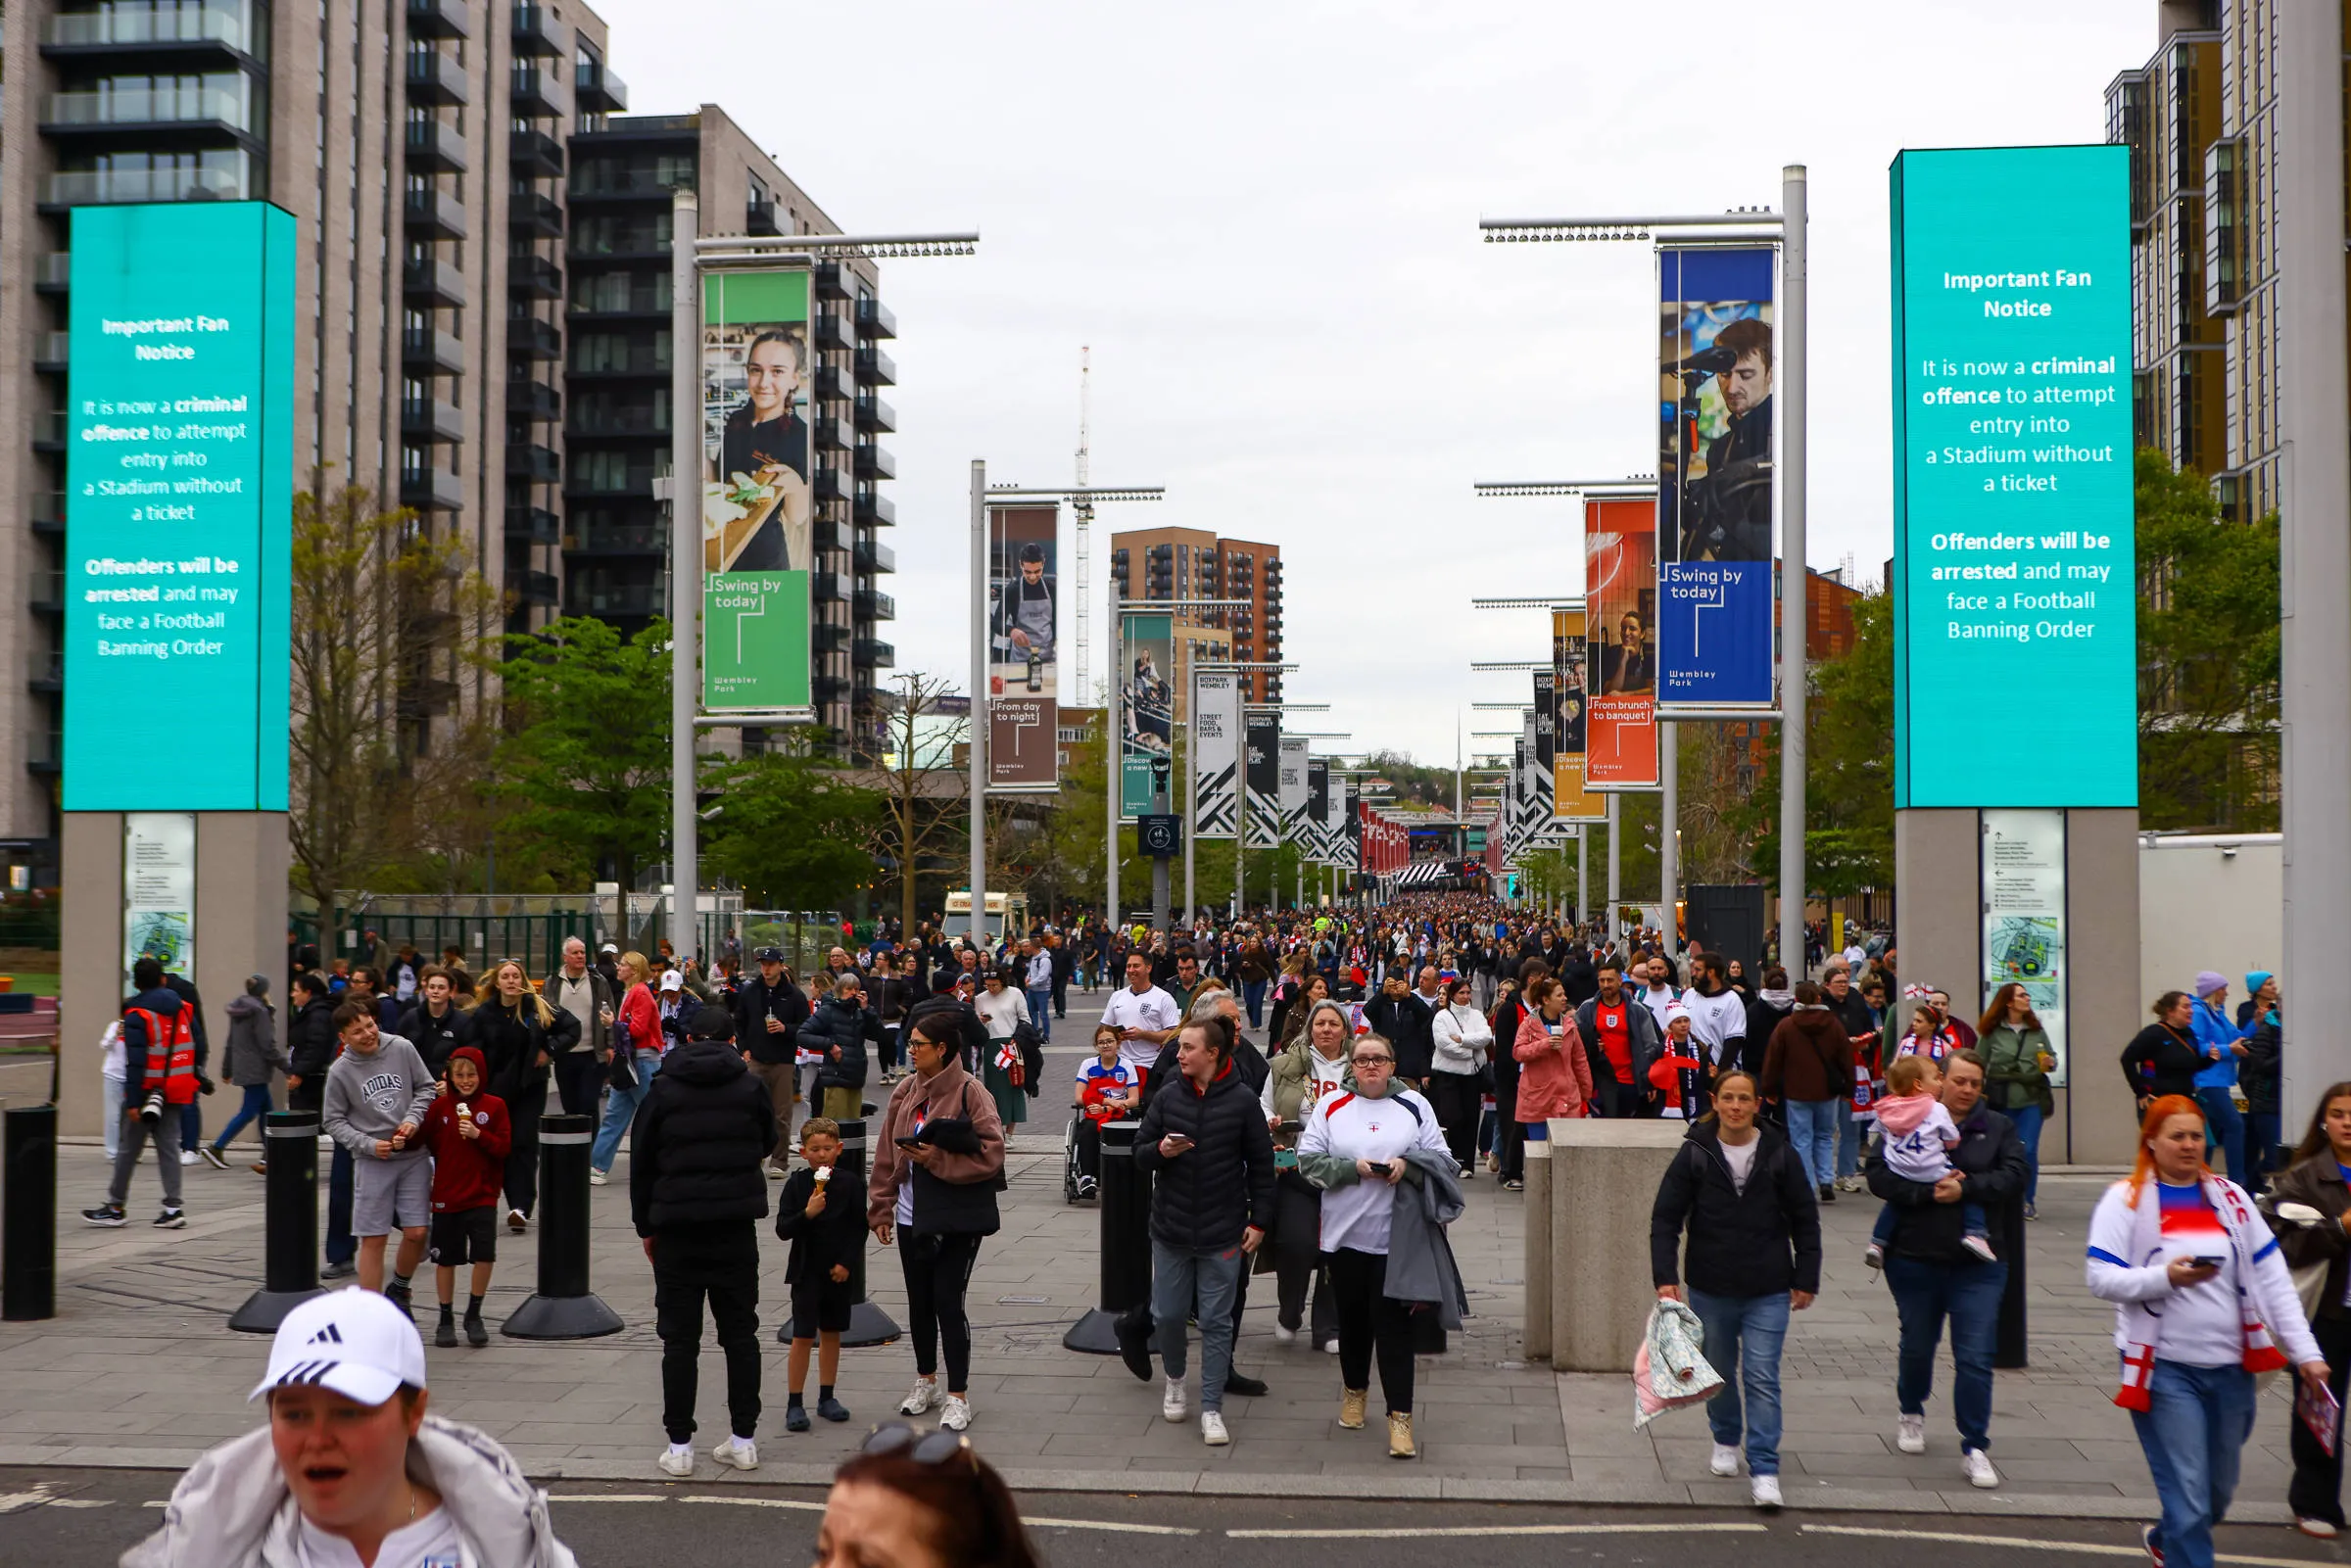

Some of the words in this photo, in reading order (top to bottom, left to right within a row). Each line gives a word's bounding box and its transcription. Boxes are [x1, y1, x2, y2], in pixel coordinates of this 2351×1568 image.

[1944, 271, 2049, 292] Important
[2056, 269, 2091, 286] Fan
[1985, 299, 2051, 317] Notice
[102, 317, 194, 337] Important
[197, 315, 229, 332] Fan
[135, 344, 195, 360] Notice
[1923, 360, 1936, 376] It
[1943, 359, 1957, 376] is
[1964, 361, 2007, 375] now
[2014, 362, 2025, 375] a
[2032, 356, 2115, 374] criminal
[1922, 387, 2000, 404] offence
[2006, 387, 2027, 403] to
[2034, 386, 2116, 406] attempt
[83, 401, 96, 415] It
[100, 400, 114, 415] is
[118, 402, 156, 414] now
[161, 401, 170, 413] a
[175, 396, 247, 413] criminal
[81, 424, 150, 441] offence
[152, 425, 171, 439] to
[176, 423, 246, 442] attempt
[1970, 417, 2023, 437] entry
[2030, 415, 2070, 432] into
[120, 452, 168, 470] entry
[172, 451, 207, 467] into
[1926, 450, 1937, 464] a
[1943, 446, 2026, 464] Stadium
[2033, 445, 2113, 462] without
[83, 483, 94, 496] a
[99, 479, 169, 496] Stadium
[173, 477, 242, 493] without
[1984, 479, 1994, 491] a
[2001, 474, 2057, 491] ticket
[131, 508, 142, 521] a
[147, 504, 195, 520] ticket
[1931, 532, 2035, 550] Offenders
[2040, 532, 2077, 549] will
[2084, 532, 2110, 549] be
[85, 558, 174, 575] Offenders
[178, 557, 210, 573] will
[215, 557, 238, 573] be
[1931, 562, 2017, 580] arrested
[2024, 561, 2060, 579] and
[2068, 565, 2111, 583] may
[1671, 569, 1717, 585] Swing
[1724, 569, 1742, 585] by
[84, 585, 159, 602] arrested
[164, 586, 196, 601] and
[201, 588, 238, 604] may
[715, 579, 758, 594] Swing
[764, 579, 781, 593] by
[1671, 585, 1717, 601] today
[715, 595, 758, 609] today
[1946, 592, 1988, 610] face
[1995, 595, 2007, 609] a
[2014, 592, 2095, 609] Football
[98, 613, 133, 629] face
[139, 616, 149, 629] a
[154, 613, 225, 628] Football
[1948, 621, 2030, 642] Banning
[2036, 620, 2095, 638] Order
[98, 640, 168, 659] Banning
[172, 639, 224, 655] Order
[1669, 670, 1716, 679] Wembley
[997, 702, 1020, 711] From
[1024, 702, 1040, 713] day
[1594, 701, 1616, 710] From
[1618, 701, 1650, 710] brunch
[1010, 713, 1035, 722] night
[1607, 712, 1645, 721] banquet
[362, 1074, 404, 1102] ADIDAS
